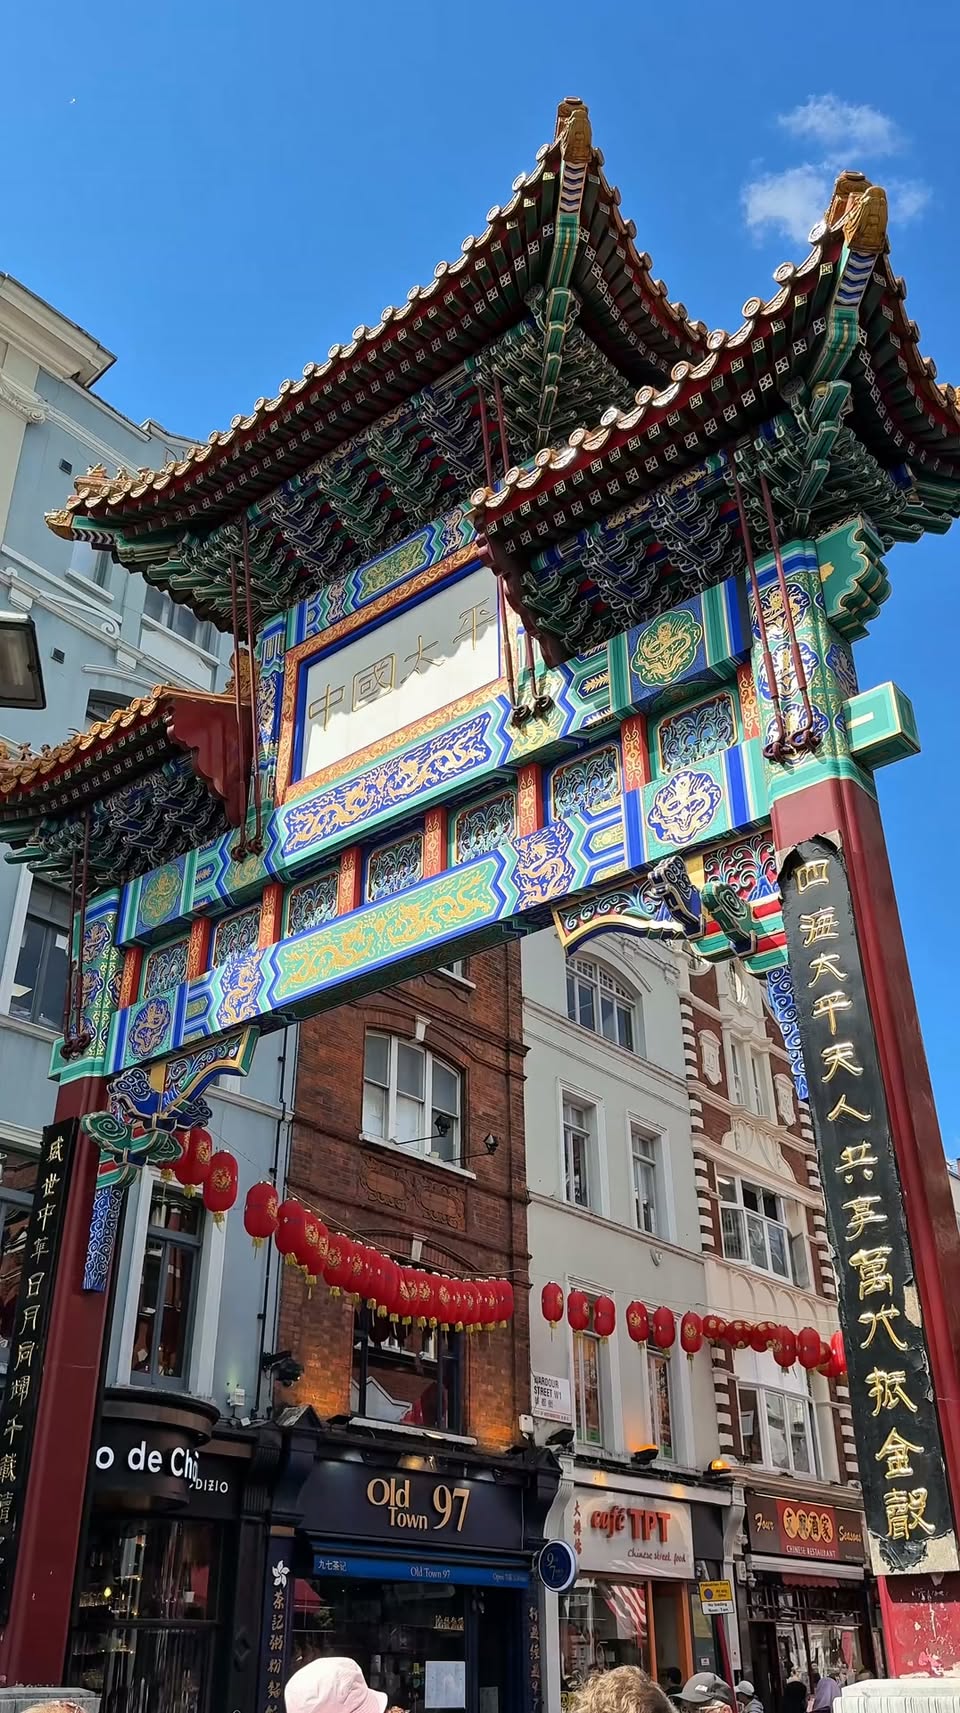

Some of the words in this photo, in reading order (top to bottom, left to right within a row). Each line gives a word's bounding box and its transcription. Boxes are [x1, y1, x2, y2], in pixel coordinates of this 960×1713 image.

[309, 597, 498, 732] 中國太平
[533, 1385, 552, 1398] STREET
[127, 1440, 163, 1473] de
[189, 1478, 229, 1493] DIZIO
[367, 1477, 410, 1508] Old
[433, 1484, 471, 1532] 97
[387, 1506, 428, 1530] Town
[590, 1505, 626, 1539] café
[627, 1508, 671, 1543] TPT
[755, 1512, 775, 1533] Four
[627, 1548, 653, 1561] Chinese
[654, 1551, 672, 1561] street
[673, 1553, 686, 1565] food
[786, 1545, 807, 1555] CHINESE
[807, 1546, 836, 1558] RESTAURANT
[410, 1566, 423, 1577] Old
[424, 1567, 442, 1578] Town
